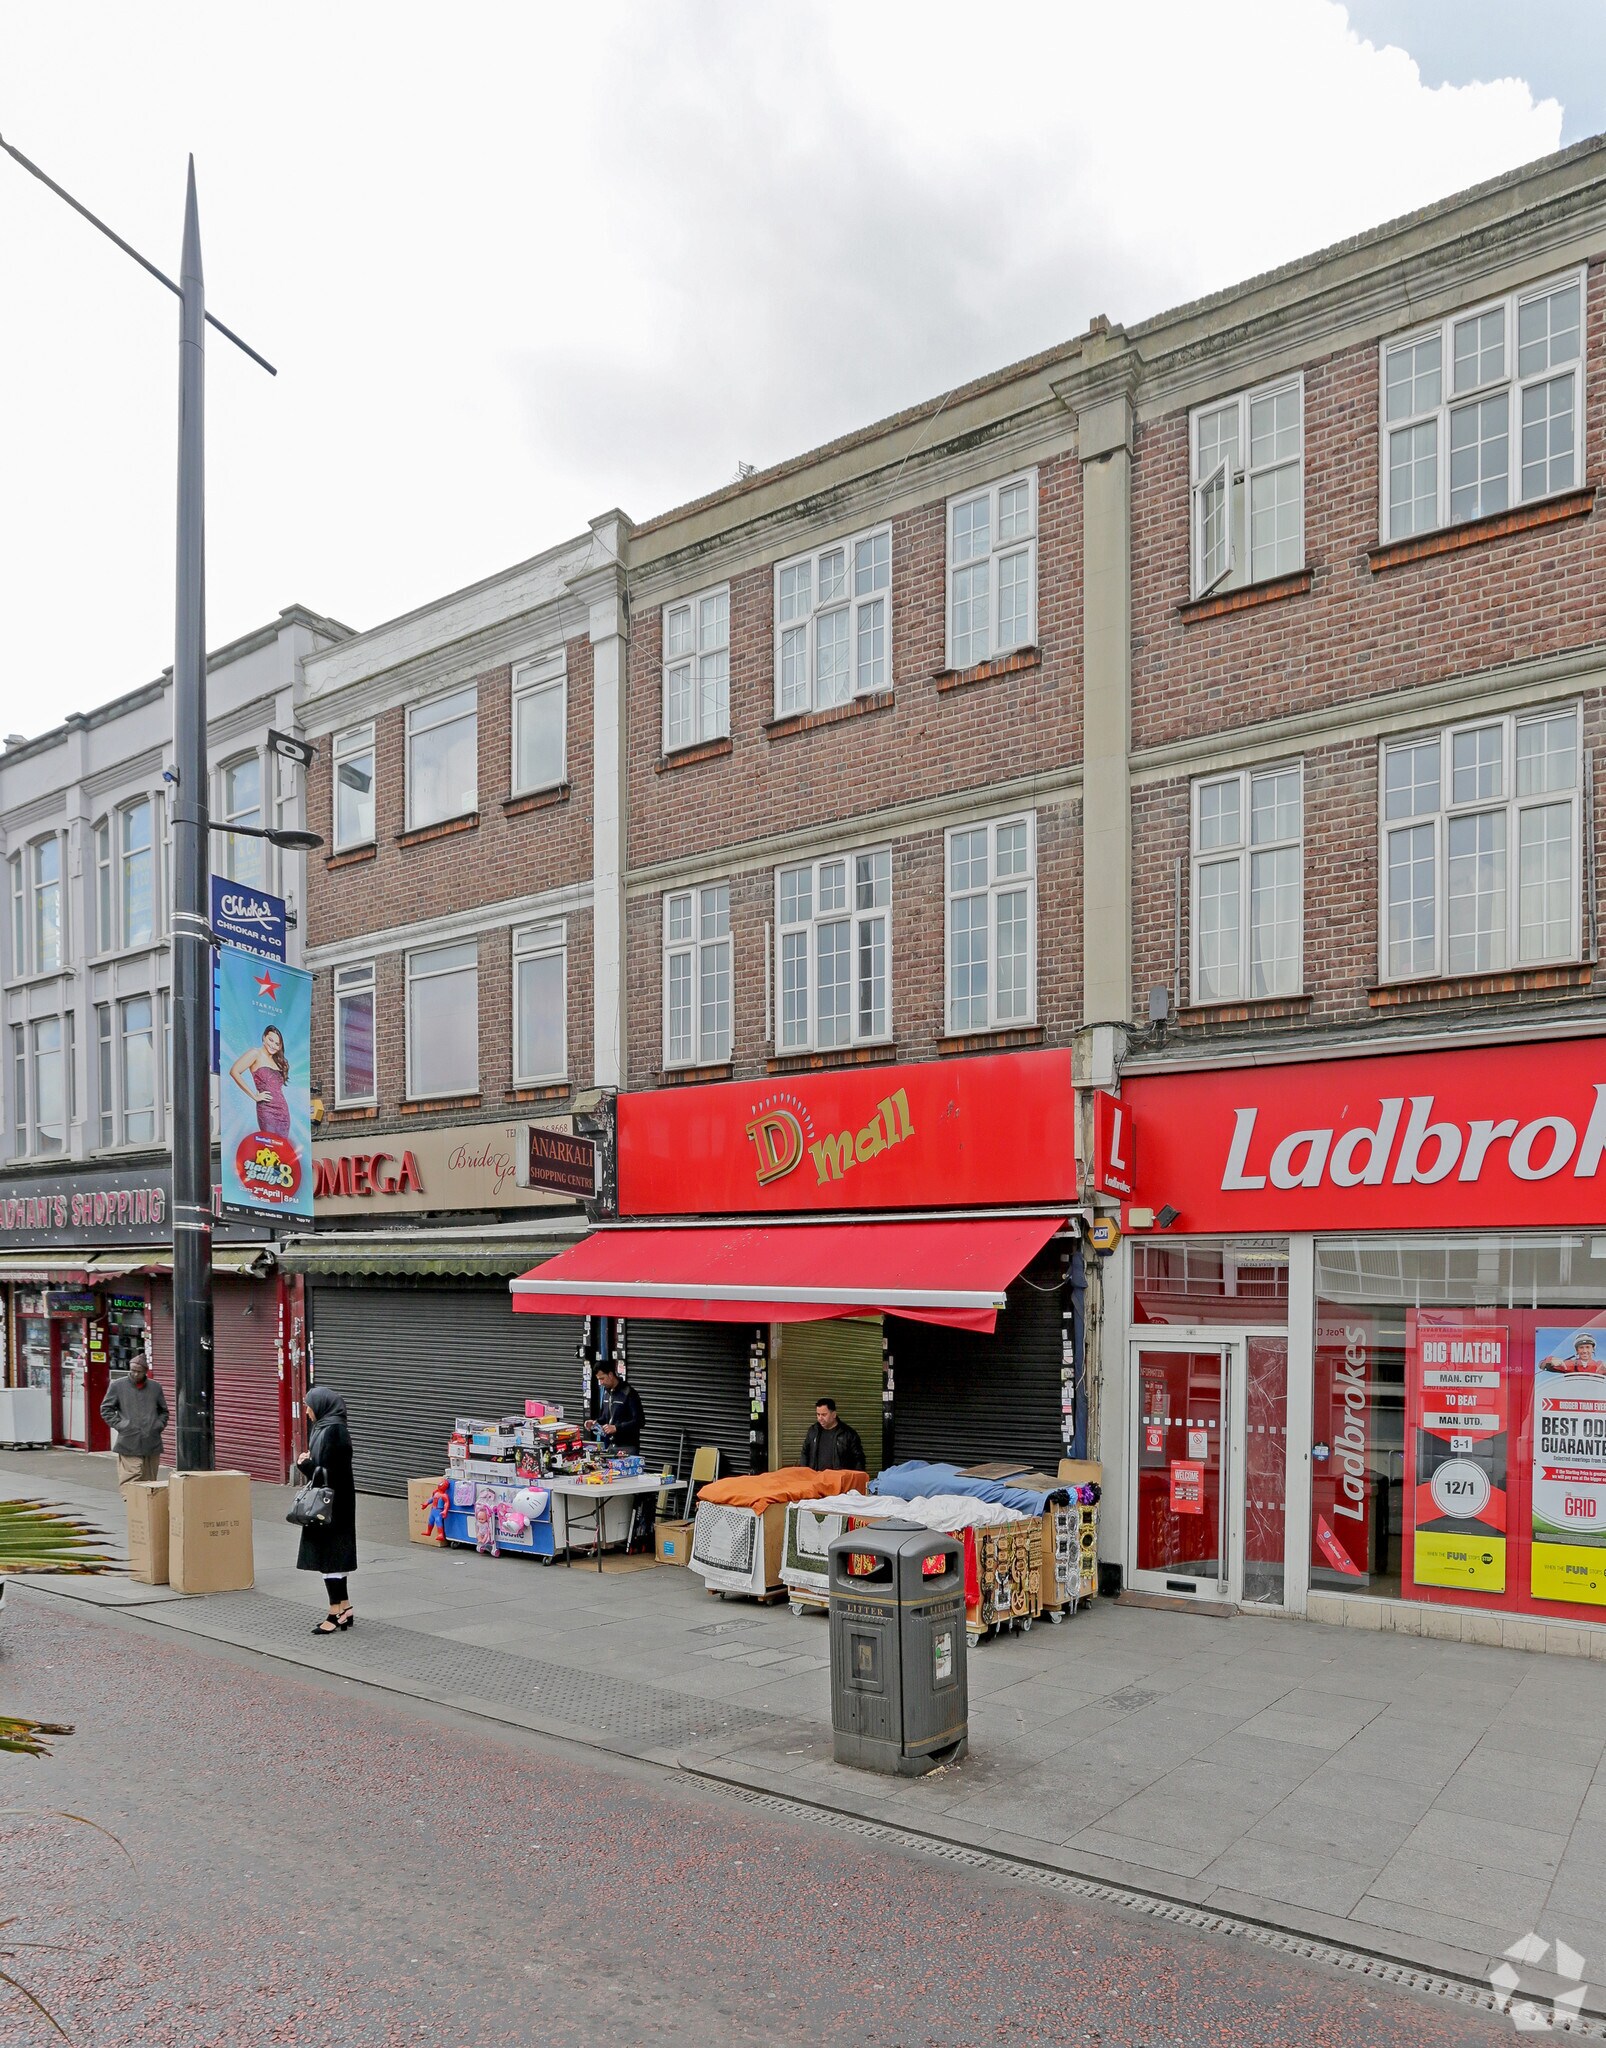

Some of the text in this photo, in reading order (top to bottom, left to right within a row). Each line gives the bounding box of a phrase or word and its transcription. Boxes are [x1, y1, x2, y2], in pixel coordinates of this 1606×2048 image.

[216, 919, 282, 947] CHHOKAR & CO
[745, 1087, 916, 1187] D mall
[1110, 1107, 1126, 1170] L
[448, 1142, 494, 1171] Bride
[531, 1135, 594, 1167] ANARKALI
[279, 1163, 294, 1188] 8
[530, 1166, 593, 1189] SHOPPING CENTRE
[263, 1190, 281, 1198] April
[72, 1187, 166, 1226] SHOPPING
[1094, 1228, 1109, 1239] ADT
[1423, 1342, 1501, 1364] BIG MATCH
[1440, 1374, 1484, 1384] MAN. CITY
[1446, 1394, 1477, 1406] TO BEAT
[1333, 1325, 1367, 1523] Ladbrokes
[1439, 1416, 1483, 1426] MAN. UTD.
[1542, 1416, 1606, 1438] BEST OD
[1453, 1439, 1469, 1448] 3-1
[1175, 1470, 1199, 1481] WELCOME
[1444, 1481, 1474, 1495] 12/1
[1564, 1497, 1597, 1518] GRID
[1446, 1551, 1467, 1562] FUN
[1566, 1564, 1588, 1576] FUN
[847, 1604, 884, 1616] LITTER
